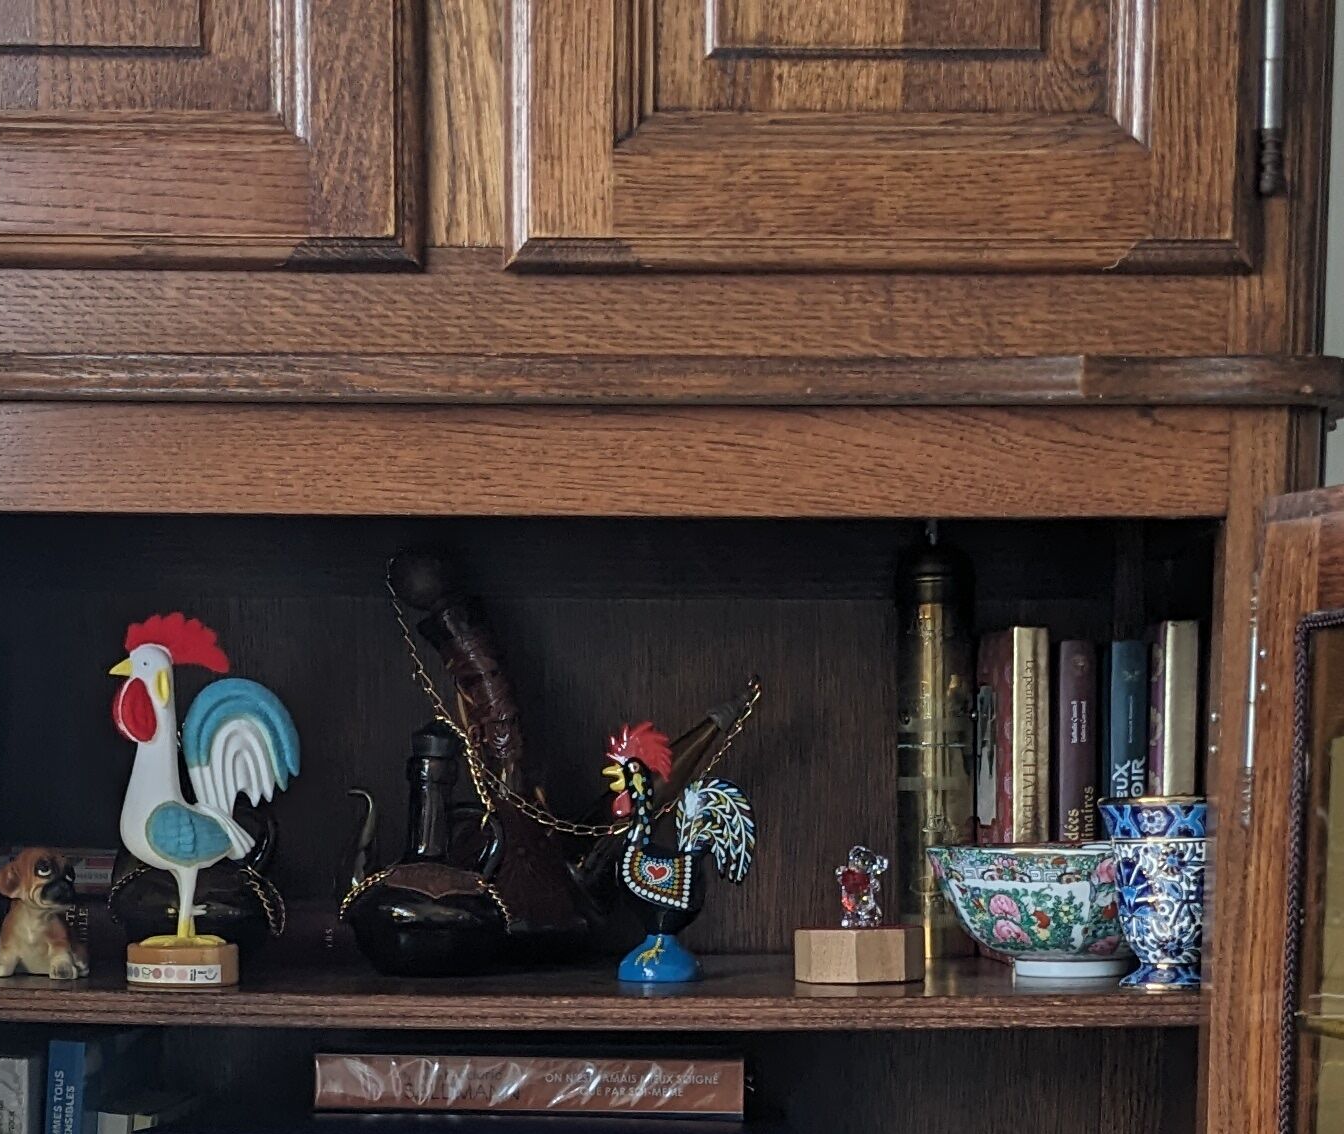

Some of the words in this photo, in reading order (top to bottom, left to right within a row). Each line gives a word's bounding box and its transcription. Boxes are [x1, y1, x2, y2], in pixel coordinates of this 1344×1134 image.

[1112, 760, 1131, 798] EUX
[1130, 755, 1146, 798] OIR
[1063, 808, 1079, 841] dées
[1080, 786, 1094, 841] linaires
[53, 1069, 65, 1103] TOUS
